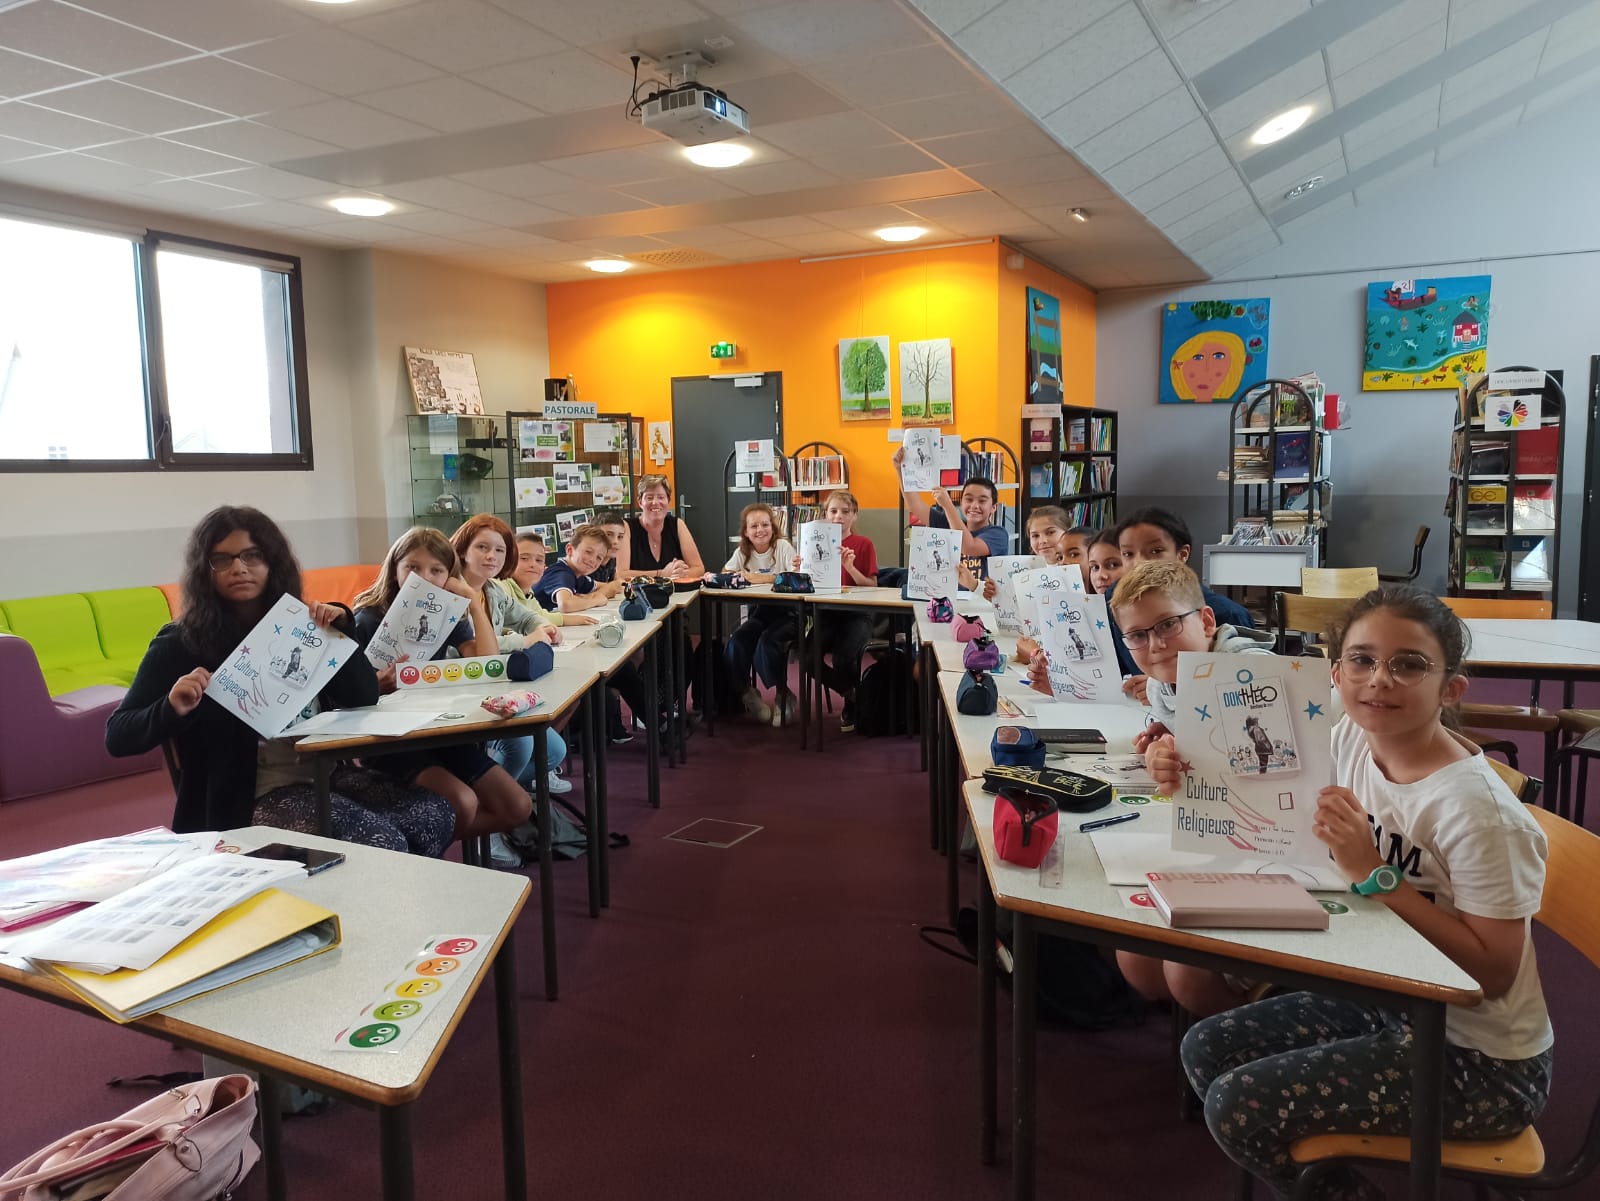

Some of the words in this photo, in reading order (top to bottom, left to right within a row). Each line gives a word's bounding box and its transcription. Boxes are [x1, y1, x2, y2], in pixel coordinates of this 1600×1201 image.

[544, 405, 595, 415] PASTORALE
[234, 655, 259, 681] Culture
[215, 668, 248, 700] Religieuse
[1186, 775, 1228, 802] Culture
[1177, 807, 1235, 838] Religieuse
